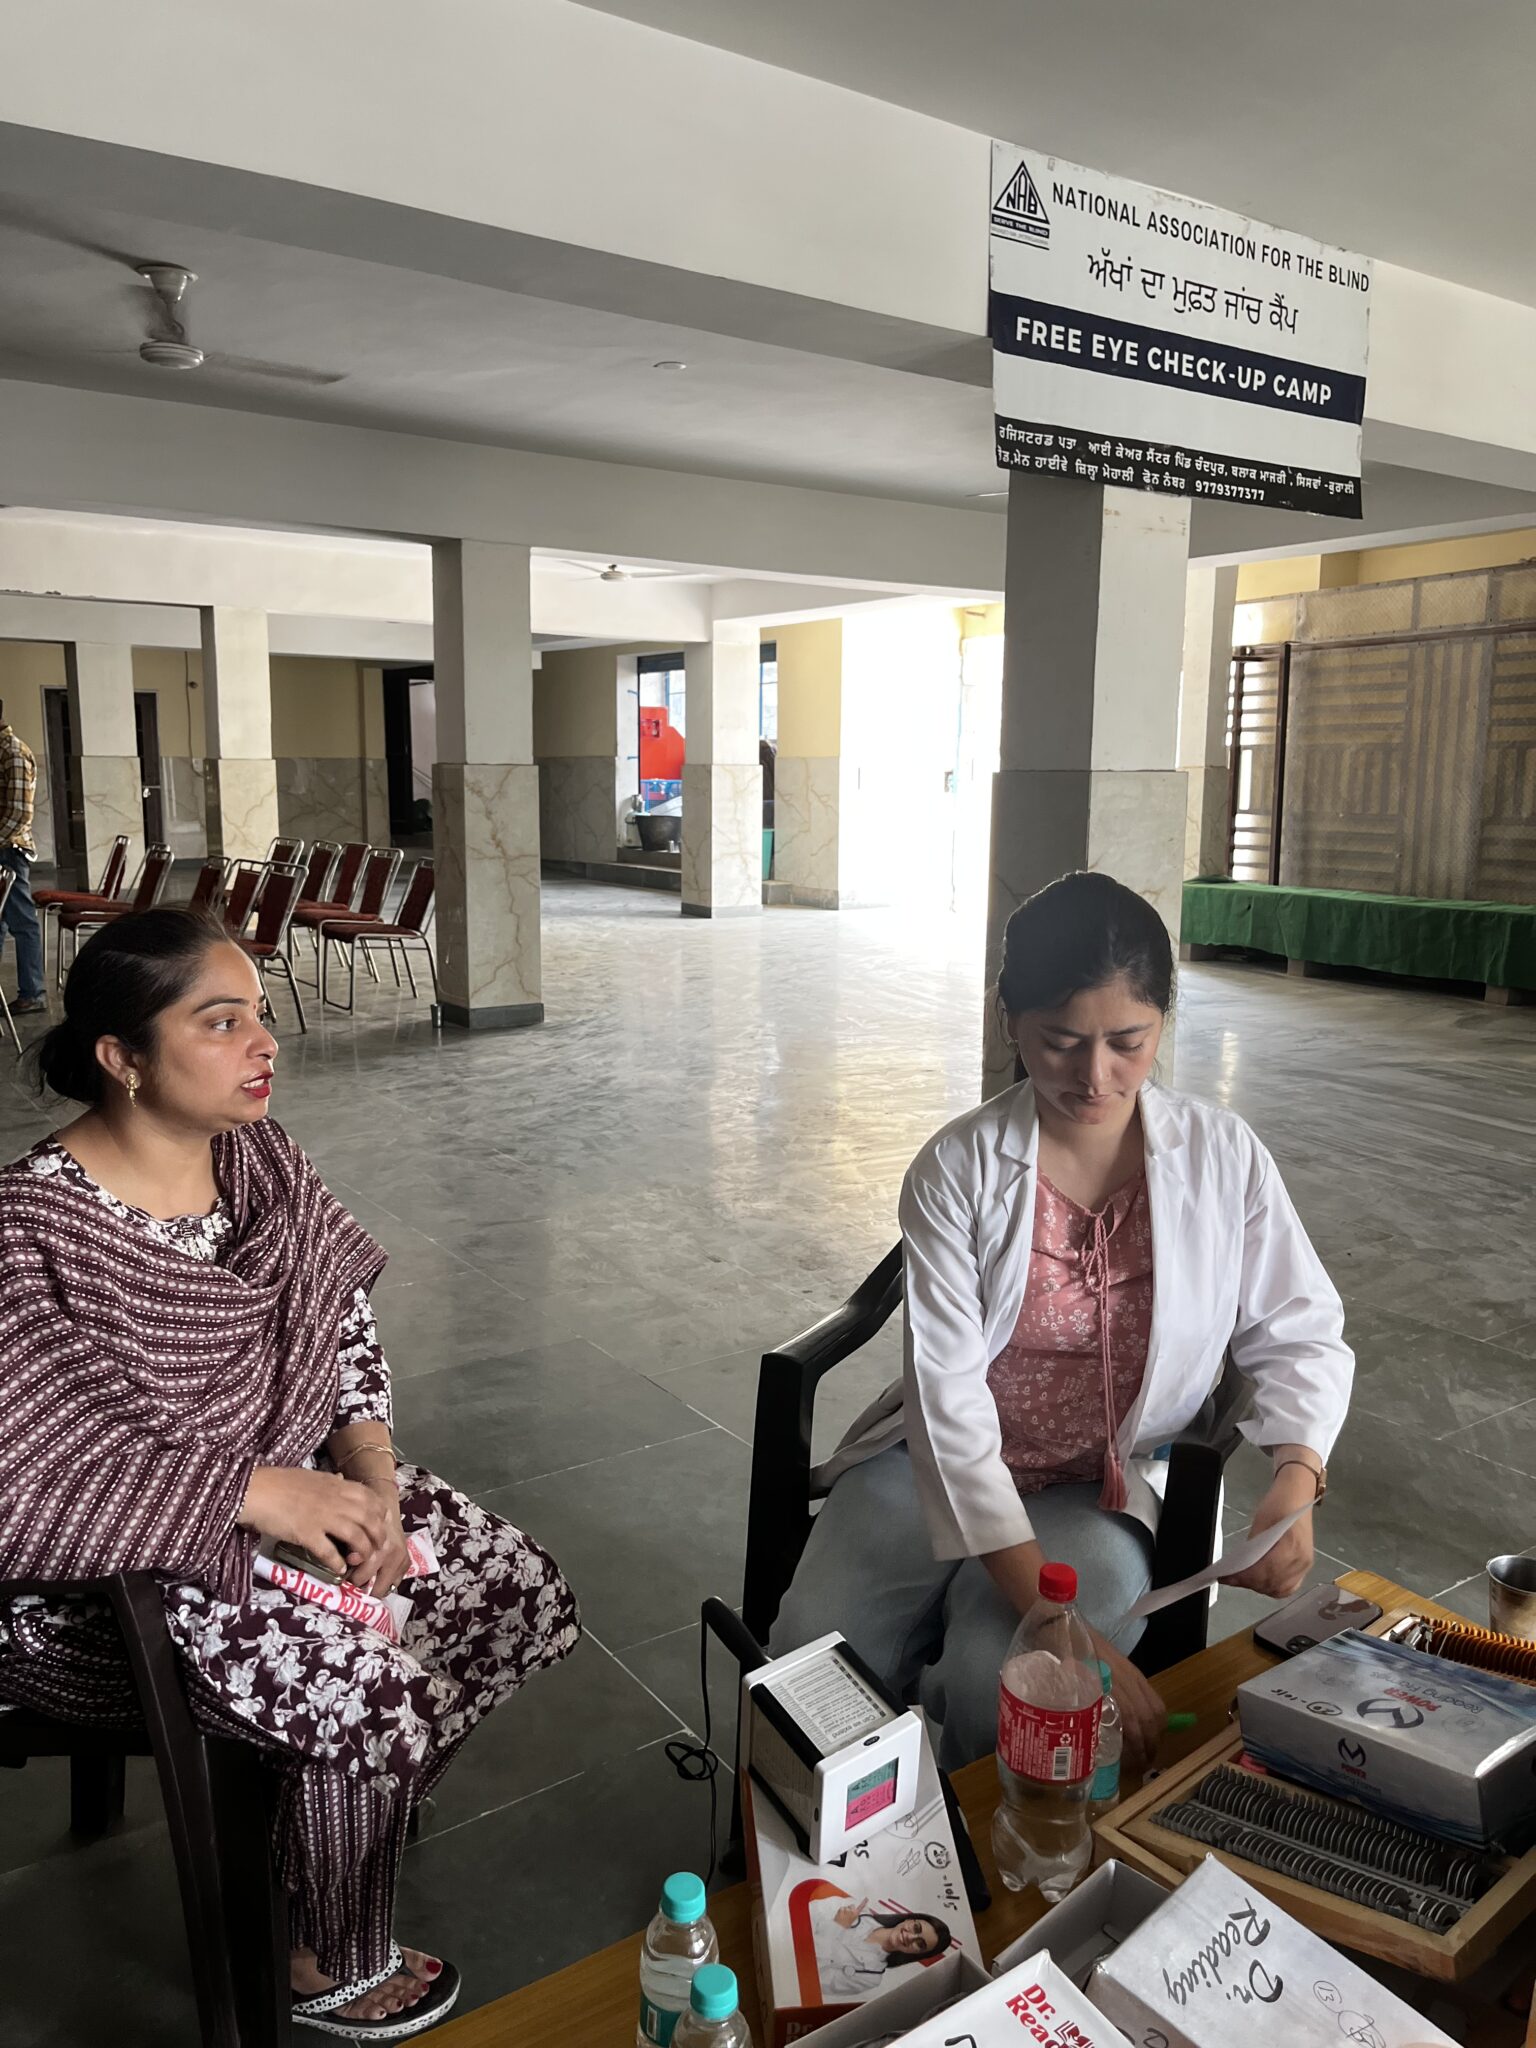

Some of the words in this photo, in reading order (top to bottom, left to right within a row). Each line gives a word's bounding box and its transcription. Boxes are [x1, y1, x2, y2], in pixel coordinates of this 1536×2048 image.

[1053, 182, 1141, 227] NATIONAL
[1147, 211, 1256, 261] ASSOCIATION
[1262, 245, 1291, 270] FOR
[1297, 255, 1324, 280] THE
[1329, 265, 1370, 293] BLIND
[1087, 247, 1133, 292] ਅੱਖਾਂ
[1141, 268, 1165, 299] ਦਾ
[1224, 286, 1263, 325] ਜਾਂਚ
[1269, 292, 1299, 335] ਕੈਂਪ
[1016, 316, 1082, 354] FREE
[1092, 334, 1139, 366] EYE
[1147, 347, 1267, 392] CHECK-UP
[1273, 374, 1332, 406] CAMP
[999, 423, 1054, 447] ਰਜਿਸਟਰਡ
[1058, 435, 1077, 450] ਪਤਾ
[1088, 440, 1111, 457] ਆਈ
[1115, 442, 1143, 461] ਕੇਅਰ
[1175, 451, 1192, 469] ਪਿੰਡ
[1231, 465, 1257, 480] ਬਲਾਕ
[1035, 454, 1068, 472] ਹਾਈਵੇ
[1163, 471, 1186, 490] ਨੰਬਰ
[1195, 480, 1266, 501] 9779377377
[1422, 1688, 1484, 1715] Reading
[1162, 1897, 1271, 2005] Reading
[1022, 1983, 1056, 2020] Dr.
[1227, 1960, 1284, 2004] Dr.
